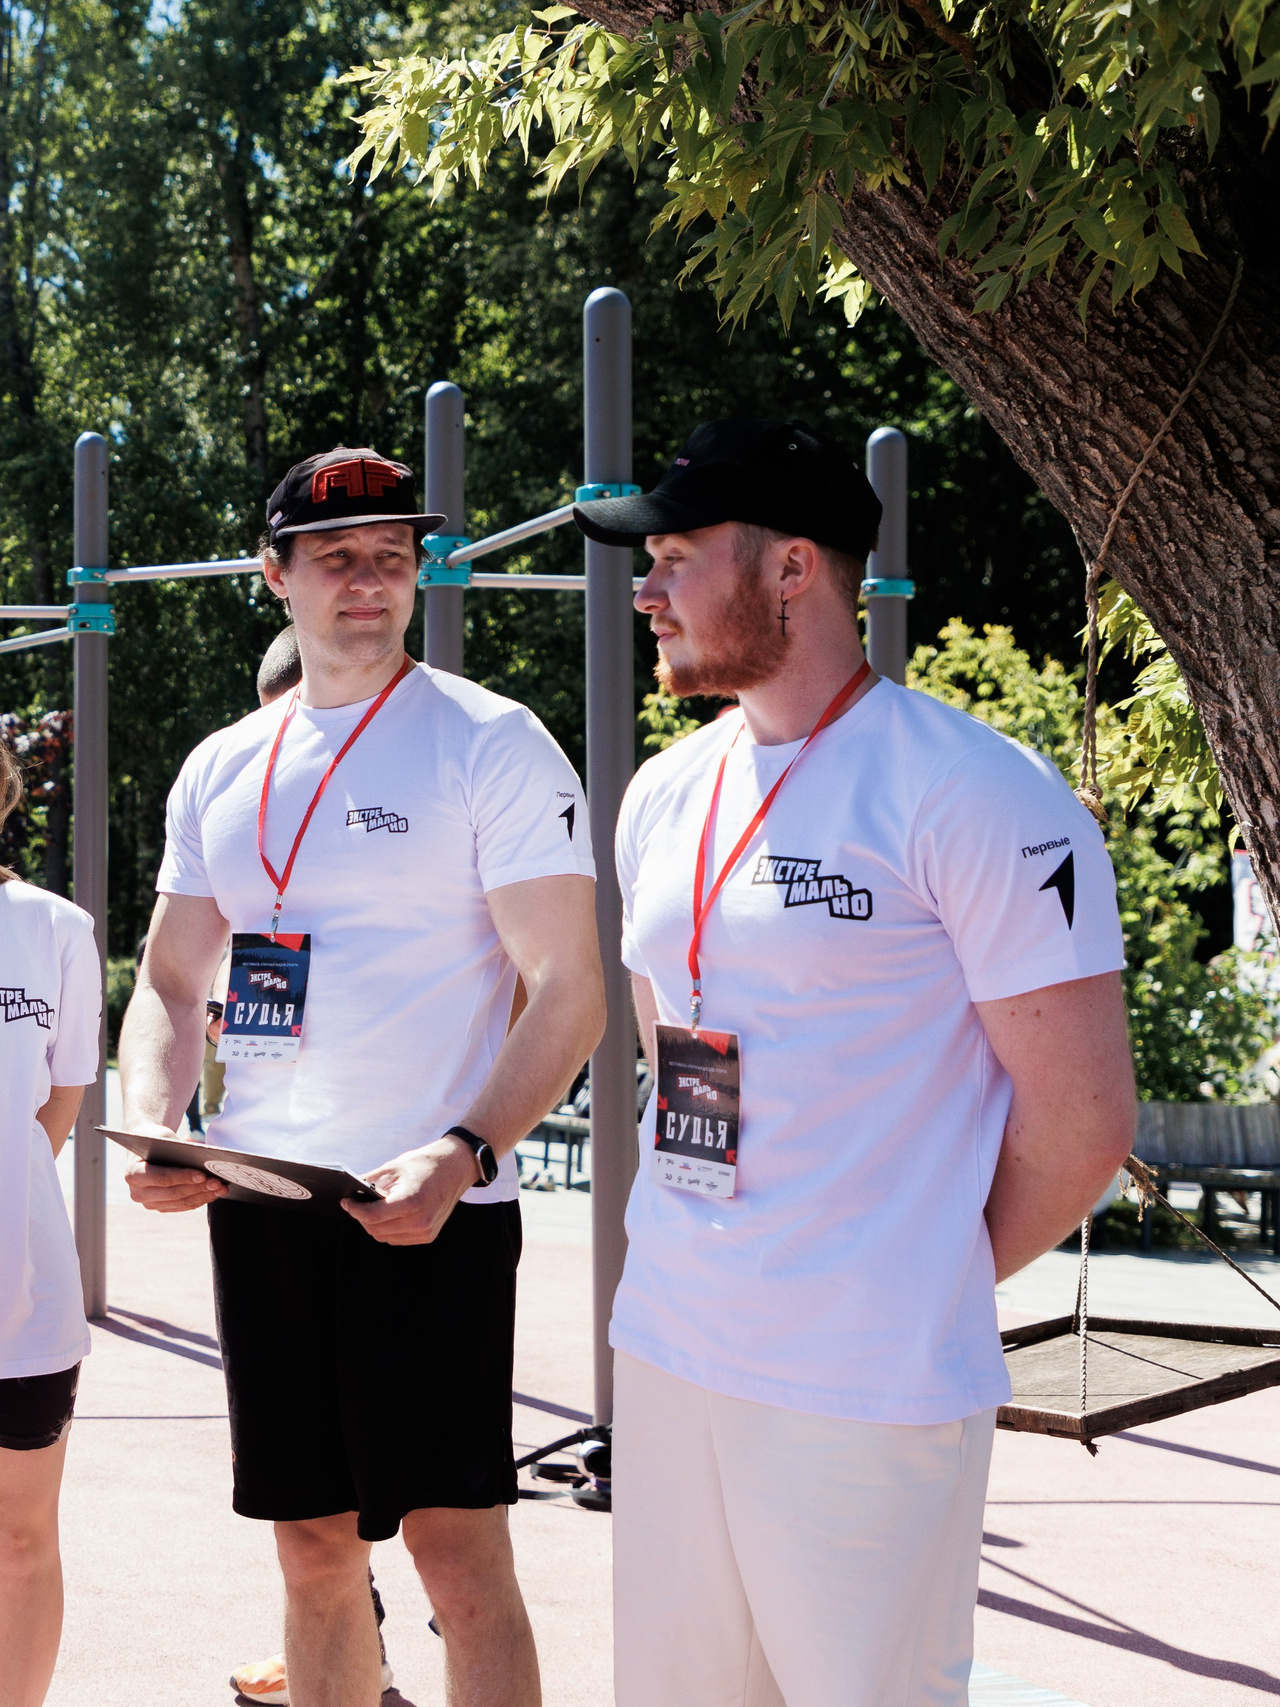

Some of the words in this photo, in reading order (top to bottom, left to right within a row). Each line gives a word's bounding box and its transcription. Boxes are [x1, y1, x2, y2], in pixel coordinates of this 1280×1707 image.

[347, 809, 381, 824] ЭКСТРЕ
[368, 815, 397, 831] МАЛЬ
[389, 819, 407, 832] НО
[1021, 836, 1071, 859] Первые
[754, 857, 818, 882] ЭКСТРЕ
[787, 878, 849, 904] МАЛЬ
[831, 892, 869, 917] НО
[7, 1001, 47, 1019] МАЛЬ
[234, 1002, 295, 1026] СУДЬЯ
[665, 1111, 728, 1150] СУДЬЯ
